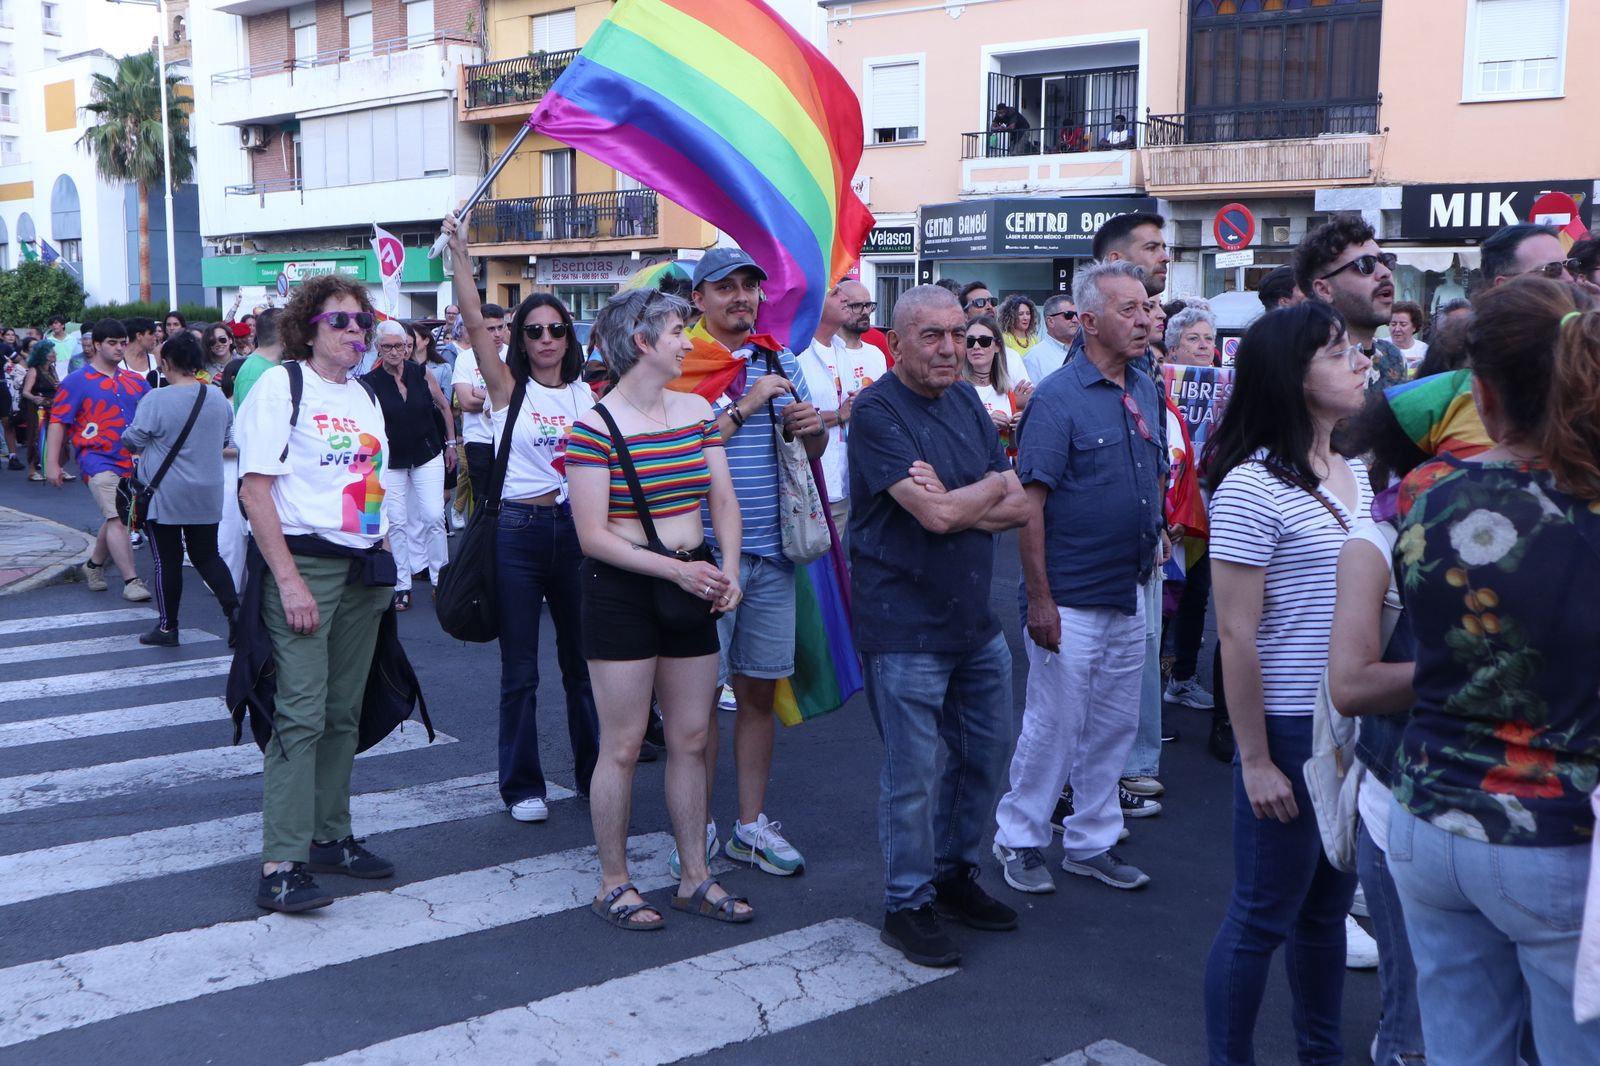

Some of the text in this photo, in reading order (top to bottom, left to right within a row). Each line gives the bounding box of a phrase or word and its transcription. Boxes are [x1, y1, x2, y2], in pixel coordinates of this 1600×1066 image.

[1429, 190, 1551, 227] MIK
[925, 210, 987, 238] CENTRO BAMBÚ
[1005, 212, 1068, 233] CENTRO
[869, 230, 911, 246] Velasco
[551, 259, 613, 273] Esencias
[616, 260, 632, 277] de
[1170, 380, 1233, 400] LIBRES
[531, 412, 566, 426] FREE
[1177, 405, 1220, 424] GUA
[313, 415, 360, 435] FREE
[533, 437, 557, 446] LOVE
[320, 452, 352, 466] LOVE
